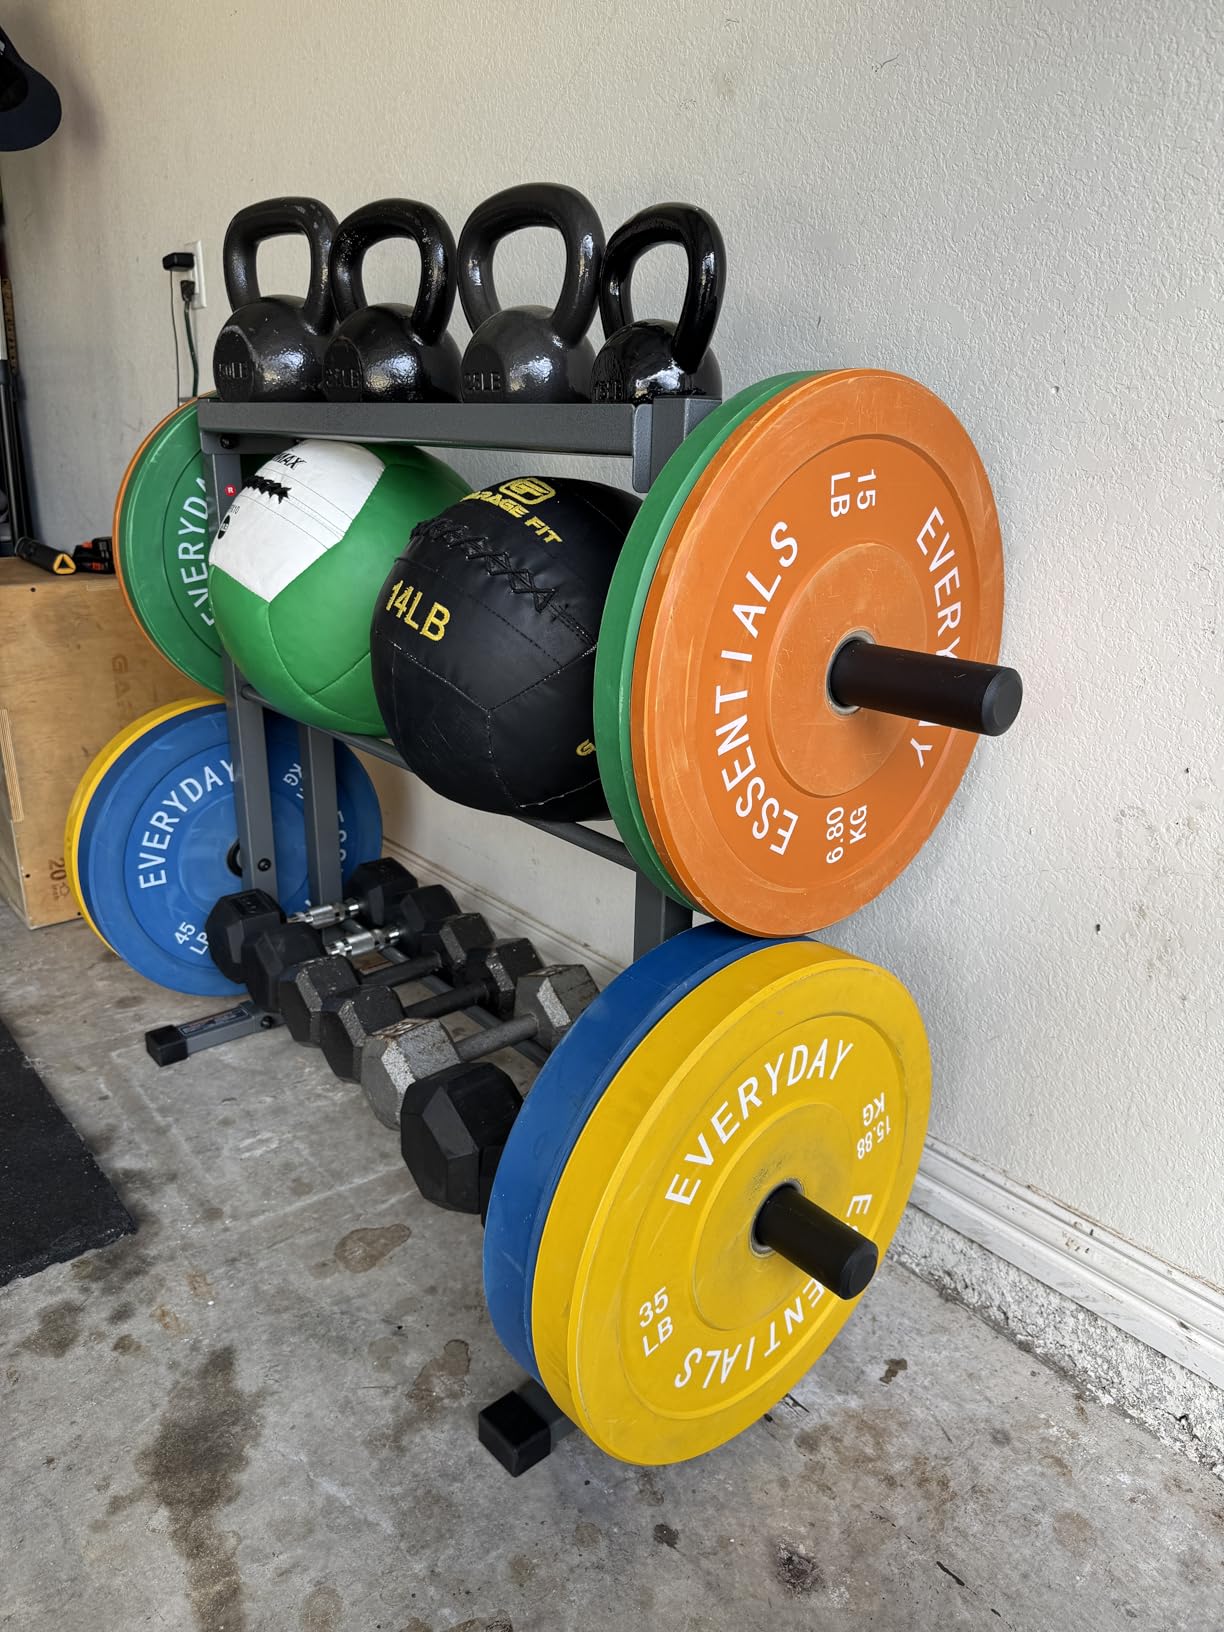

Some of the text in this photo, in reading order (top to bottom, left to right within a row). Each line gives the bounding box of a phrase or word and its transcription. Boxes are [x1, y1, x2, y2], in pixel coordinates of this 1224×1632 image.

[463, 372, 501, 392] 25LB
[829, 471, 851, 518] LB
[856, 467, 878, 511] 15
[524, 516, 563, 543] FIT
[385, 580, 451, 642] 14LB
[910, 506, 961, 769] EVERYY
[714, 521, 799, 856] ESSENTIALS
[283, 763, 302, 786] KG
[136, 758, 236, 889] EVERYDAY
[825, 806, 844, 864] 6.80
[848, 804, 869, 844] KG
[174, 921, 196, 945] 45
[664, 1038, 855, 1206] EVERYDAY
[863, 1092, 886, 1127] KG
[857, 1114, 892, 1161] 15.88
[638, 1286, 670, 1328] 35
[642, 1318, 674, 1357] LB
